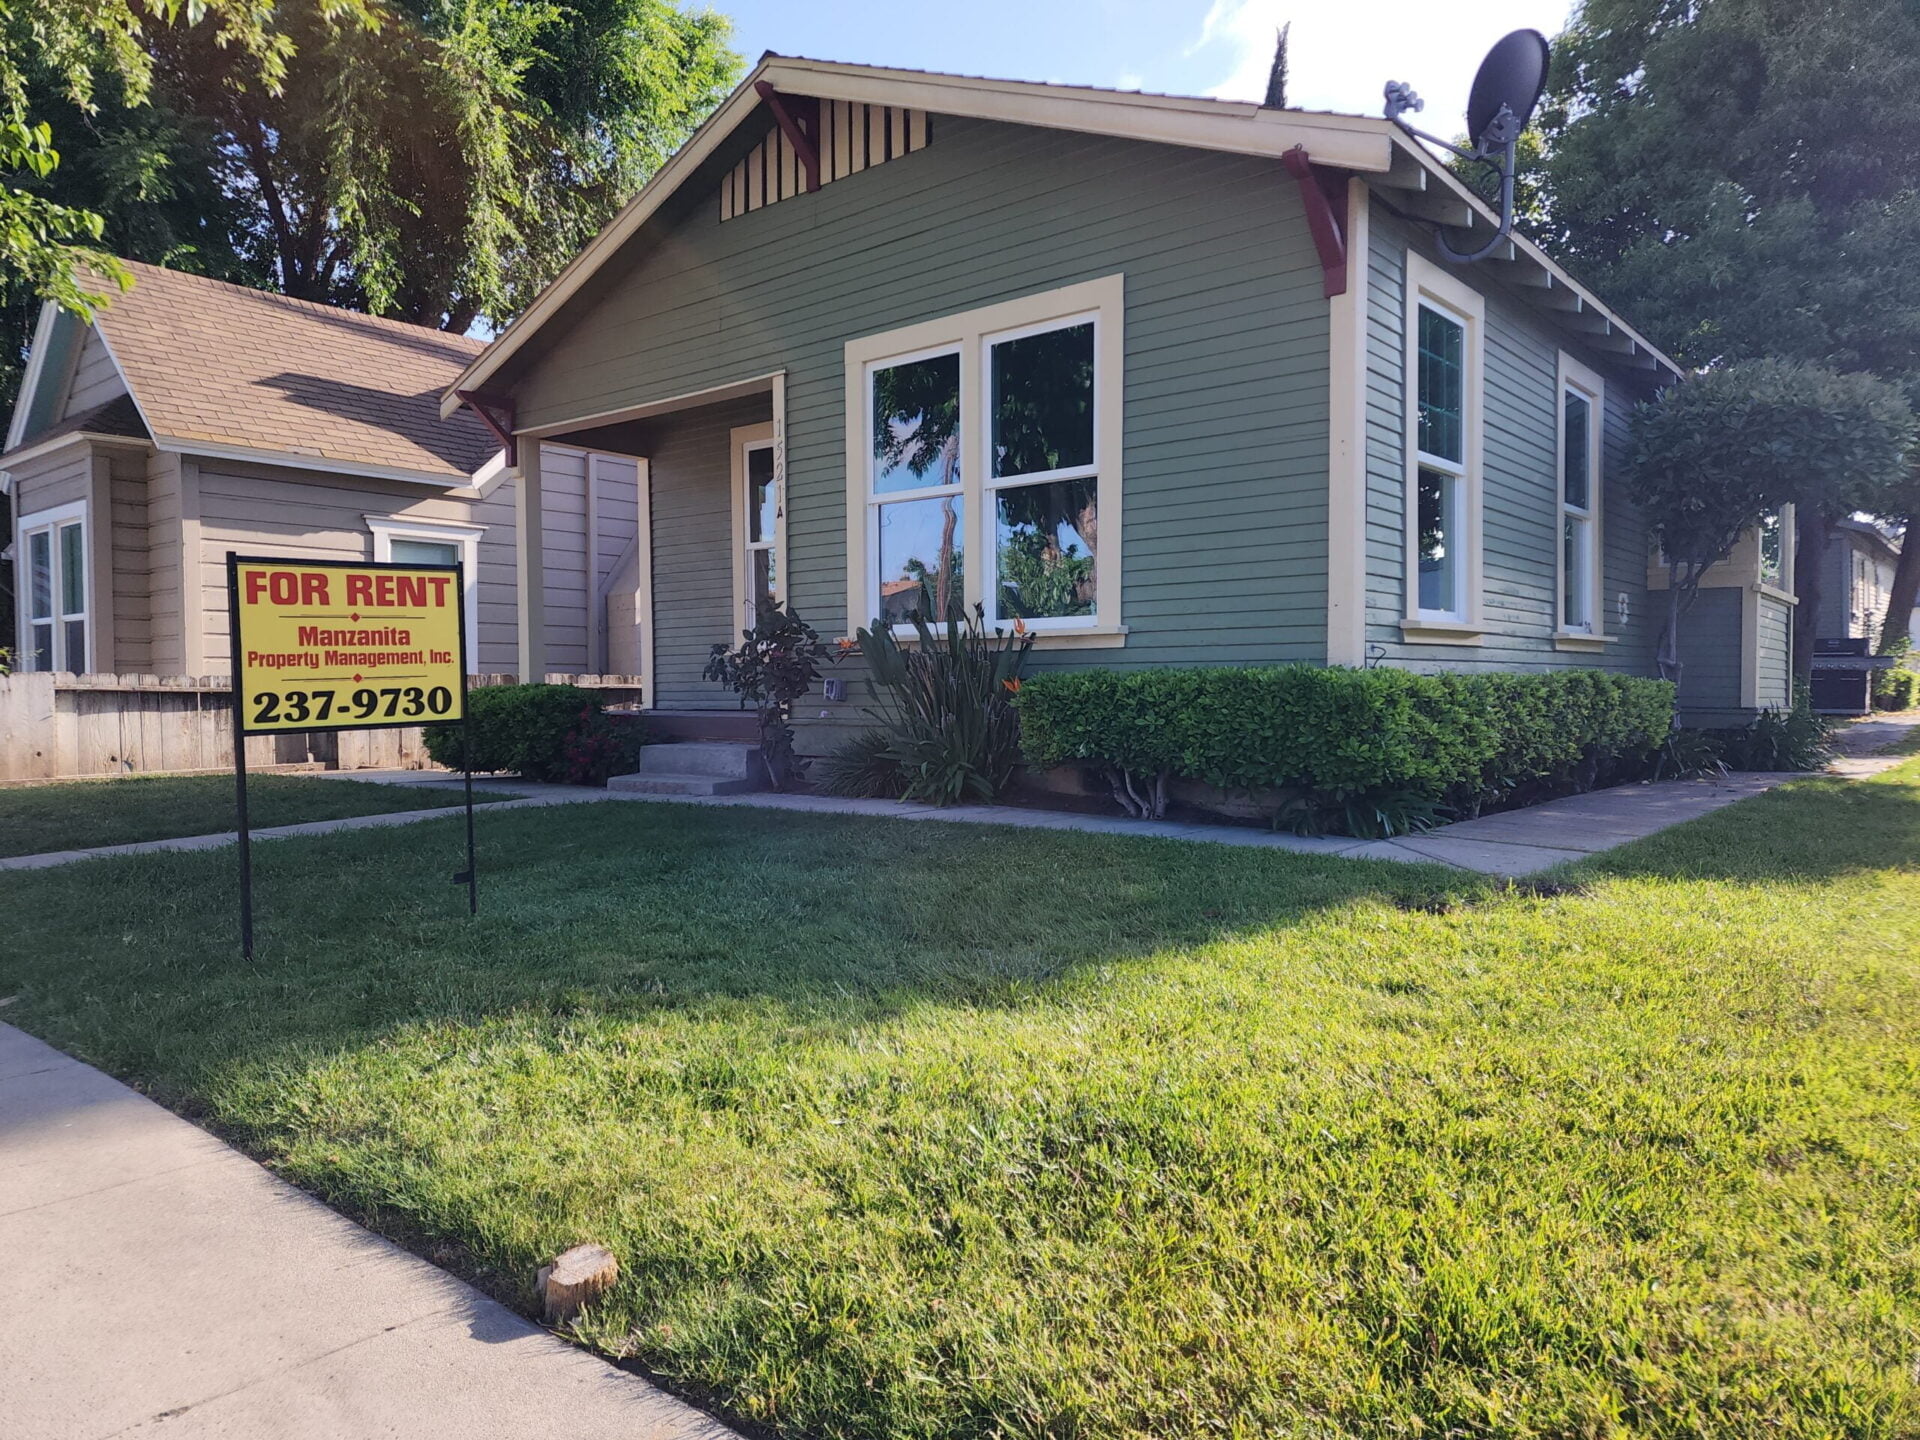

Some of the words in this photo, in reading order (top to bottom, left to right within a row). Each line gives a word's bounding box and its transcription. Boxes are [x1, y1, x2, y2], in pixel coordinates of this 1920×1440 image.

[245, 571, 330, 606] FOR
[346, 574, 451, 607] RENT
[298, 626, 411, 647] Manzanita
[247, 651, 319, 670] Property
[324, 650, 427, 668] Management,
[430, 649, 455, 664] Inc.
[252, 686, 453, 724] 237-9730
